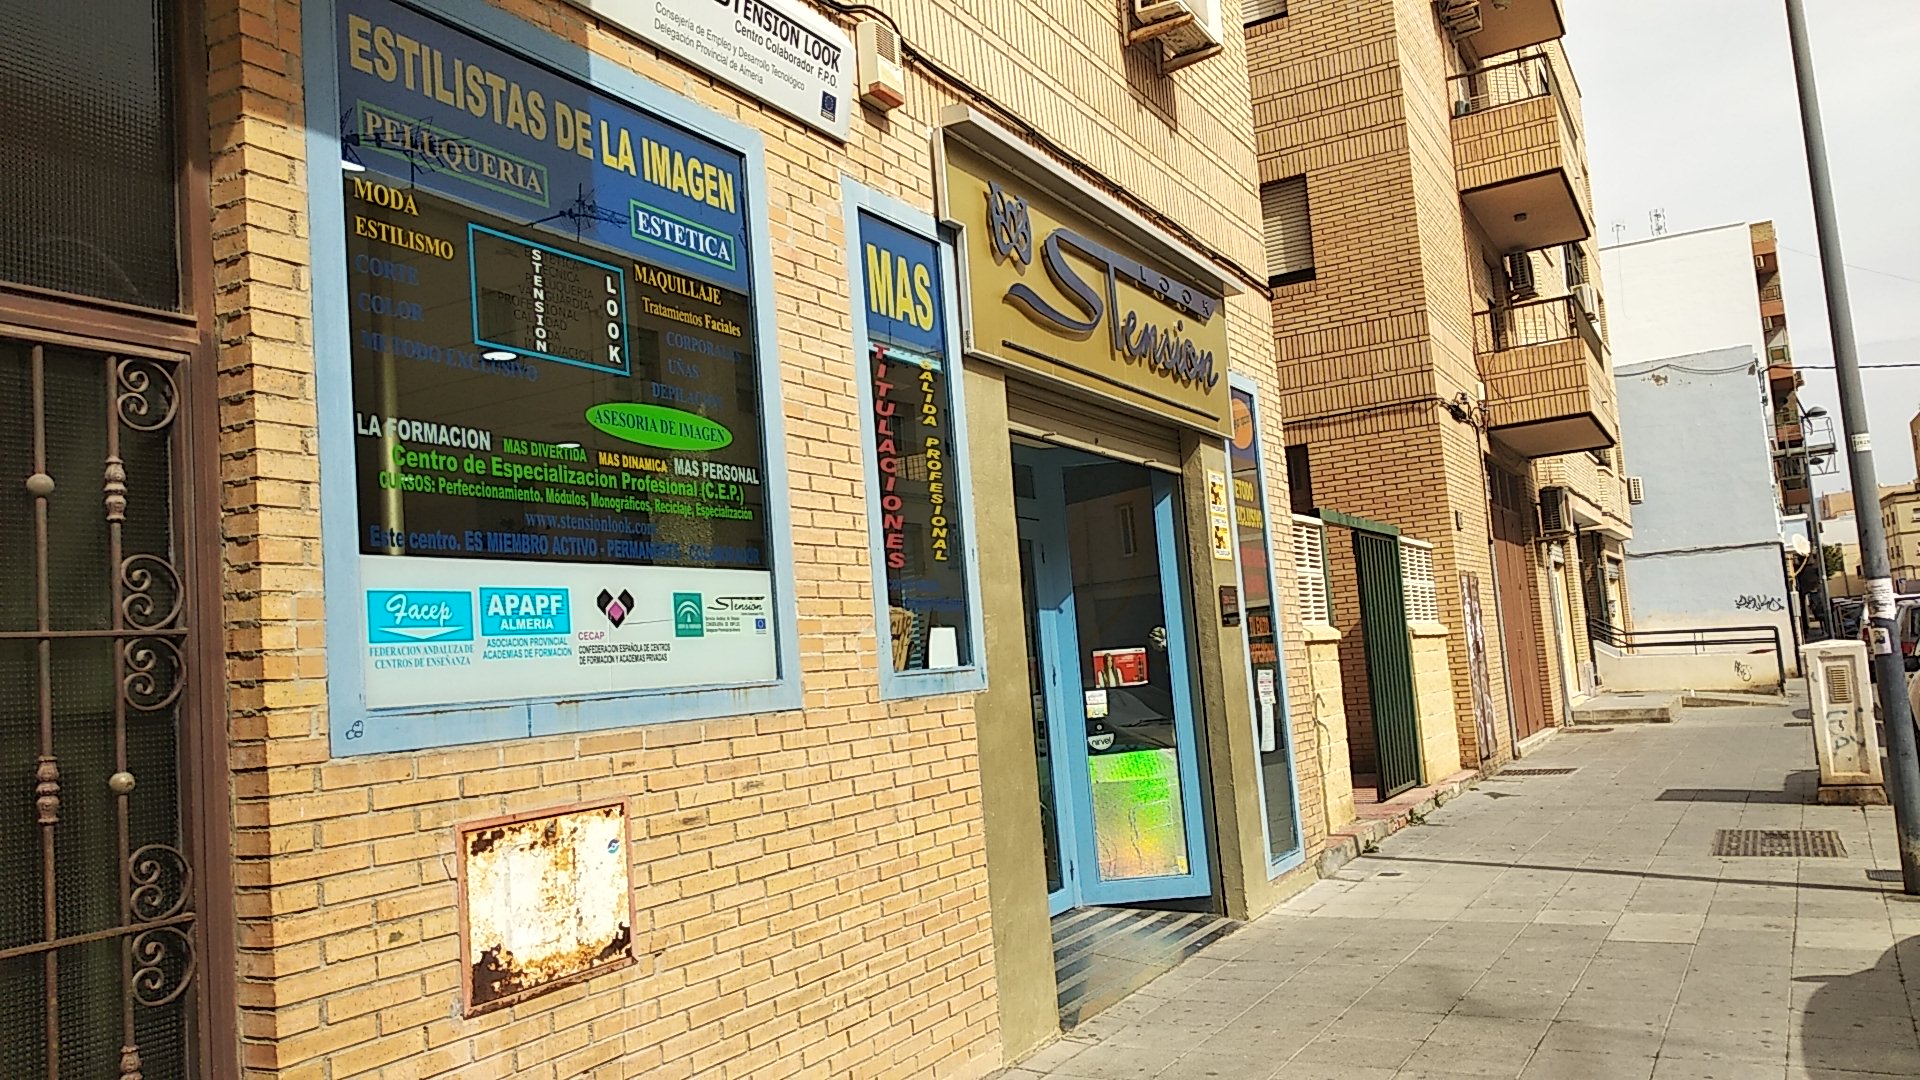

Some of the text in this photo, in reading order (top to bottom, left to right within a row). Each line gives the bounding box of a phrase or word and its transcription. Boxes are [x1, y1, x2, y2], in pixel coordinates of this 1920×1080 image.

[696, 25, 705, 36] de
[706, 29, 732, 51] Empleo
[732, 45, 738, 57] y
[739, 46, 770, 73] Desarrollo
[696, 42, 728, 67] Provincial
[729, 58, 738, 71] de
[735, 19, 838, 89] Centro Colaborador F.P.O.
[804, 34, 841, 73] LOOK
[348, 13, 737, 214] ESTILISTAS DE LA IMAGEN
[363, 110, 543, 194] PELUQUERIA
[353, 177, 420, 217] MODA
[355, 215, 455, 260] ESTILISMO
[637, 210, 730, 262] ESTETICA
[355, 254, 420, 287] CORTE
[634, 263, 722, 306] MAQUILLAJE
[866, 243, 934, 332] MAS
[357, 293, 424, 322] COLOR
[531, 249, 549, 353] STENSION
[606, 275, 622, 364] LOOK
[642, 296, 742, 338] Tratamientos Faciales
[668, 359, 700, 380] UÑAS
[357, 412, 491, 451] LA FORMACION
[594, 409, 726, 443] ASESORIA DE IMAGEN
[392, 445, 744, 505] Centro de Especializacion Profesional (C.E.P.)
[503, 438, 759, 485] MAS DIVERTIDA MAS DINAMICA MAS PERSONAL
[873, 343, 905, 569] TITULACIONES
[919, 359, 948, 561] SALIDA PROFESIONAL
[546, 488, 589, 510] Módulos,
[369, 525, 404, 548] Este
[465, 531, 483, 552] ES
[487, 531, 548, 554] MIEMBRO
[552, 536, 597, 557] ACTIVO
[385, 593, 453, 627] Facep
[487, 594, 563, 616] APAPF
[500, 618, 554, 631] ALMERIA
[369, 643, 474, 658] FEDERACION ANDALUZA DE
[483, 647, 572, 660] ACADEMIAS DE FORMACION
[487, 637, 568, 648] ASOCIACION PROVINCIAL
[578, 631, 605, 640] CECAP
[375, 655, 471, 670] CENTROS DE ENSEÑANZA
[1091, 736, 1112, 746] nirvel
